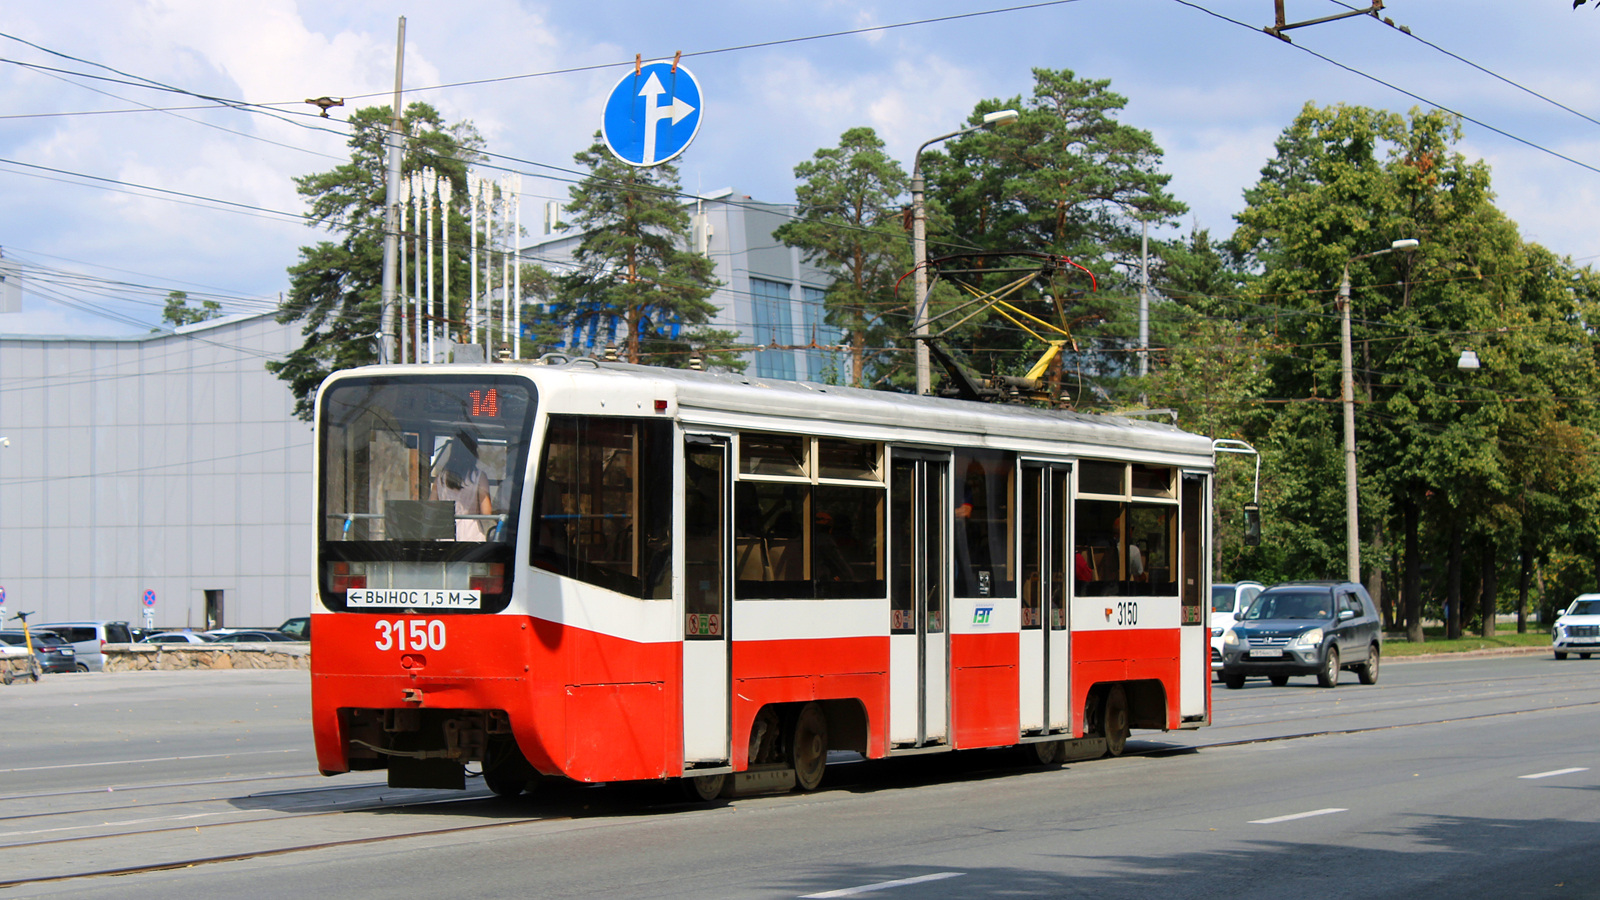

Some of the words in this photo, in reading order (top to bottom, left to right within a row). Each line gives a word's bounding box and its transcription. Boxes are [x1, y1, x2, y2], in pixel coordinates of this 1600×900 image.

[469, 388, 497, 417] 14
[365, 591, 418, 604] ВЫНОС
[423, 592, 444, 606] 1,5
[448, 592, 460, 605] М
[1117, 601, 1138, 626] 3150
[374, 619, 446, 651] 3150
